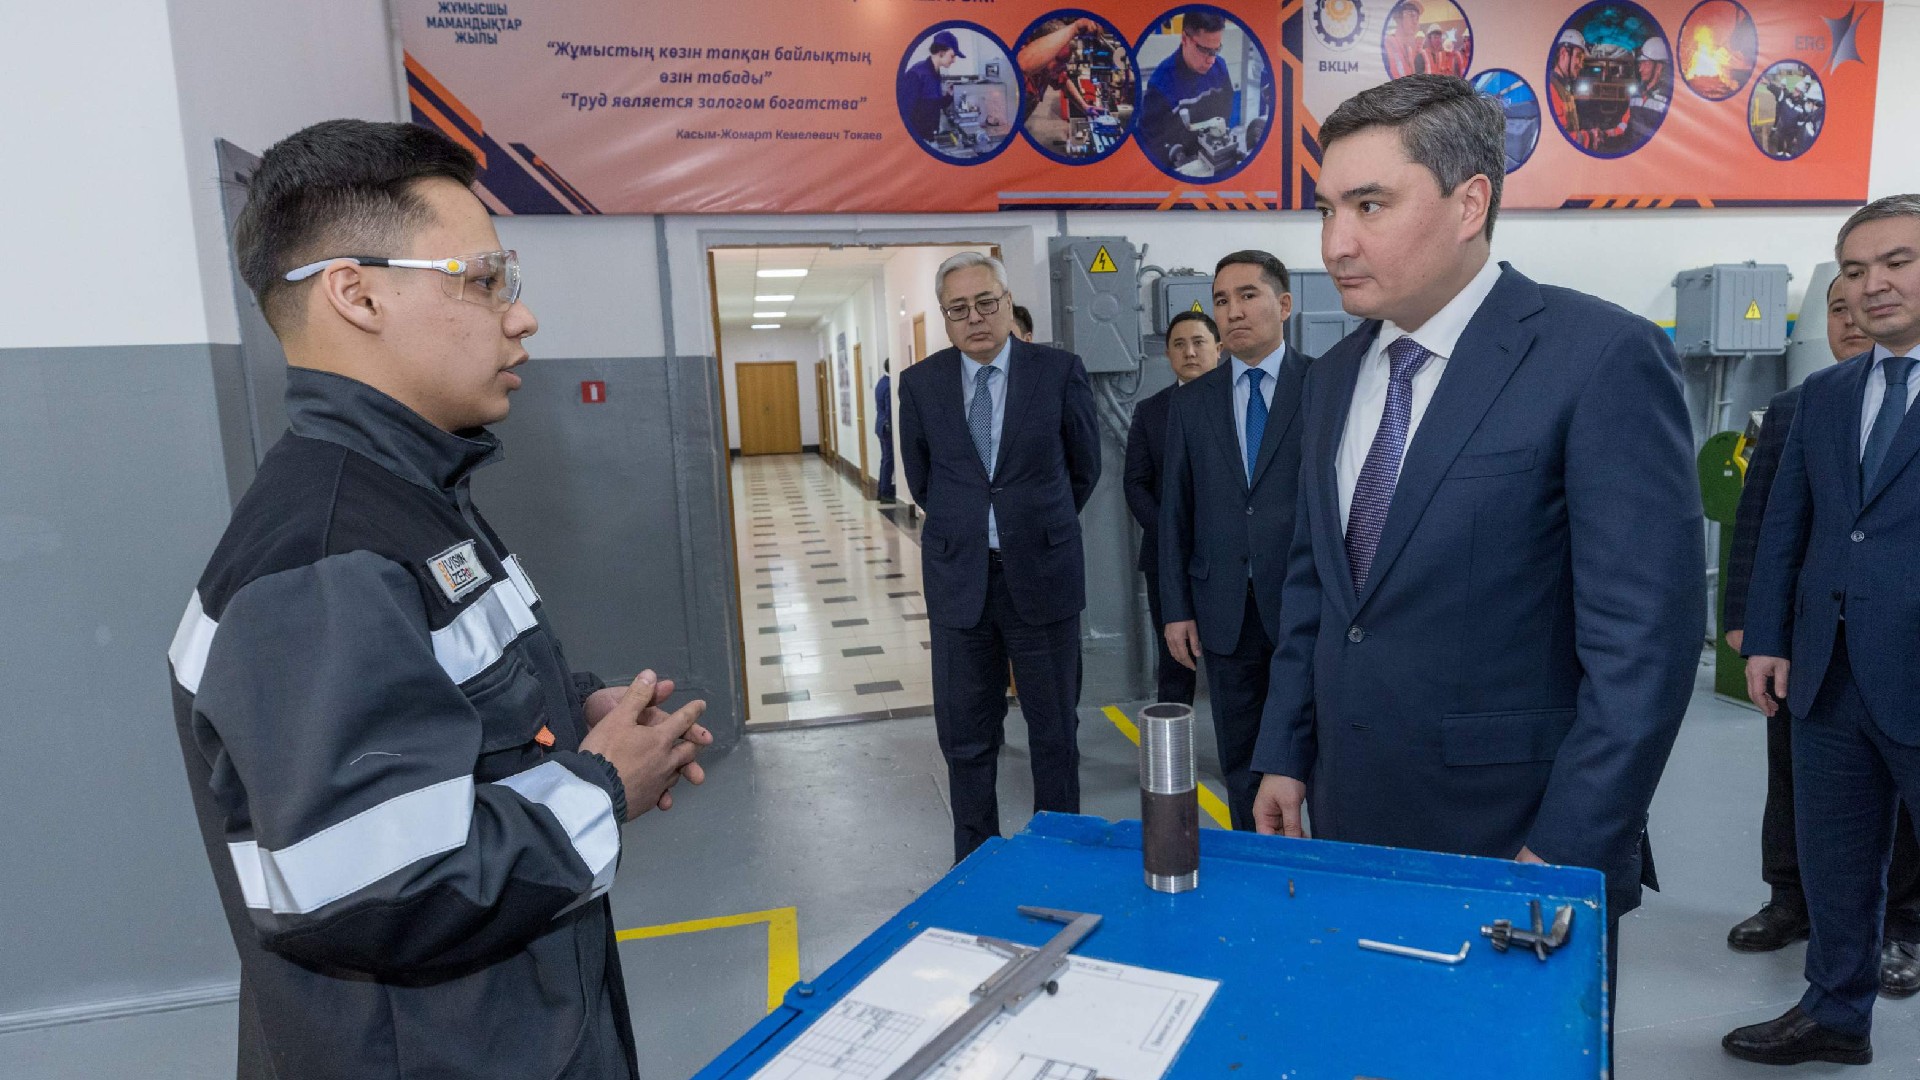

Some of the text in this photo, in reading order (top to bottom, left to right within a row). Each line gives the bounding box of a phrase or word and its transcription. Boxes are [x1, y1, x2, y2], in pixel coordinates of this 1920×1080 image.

[438, 1, 507, 15] ЖҰМЫСШЫ
[426, 16, 522, 32] МАМАНДЫҚТАР
[455, 31, 498, 44] ЖЫЛЫ
[659, 47, 701, 59] көзін
[706, 48, 770, 63] тапқан
[774, 46, 872, 65] байлықтың
[1319, 60, 1359, 74] ВКЦМ
[659, 71, 692, 84] өзін
[611, 97, 693, 108] является
[698, 97, 765, 109] залогом
[676, 128, 882, 142] Касым-Жомарт Кемелевич Токаев
